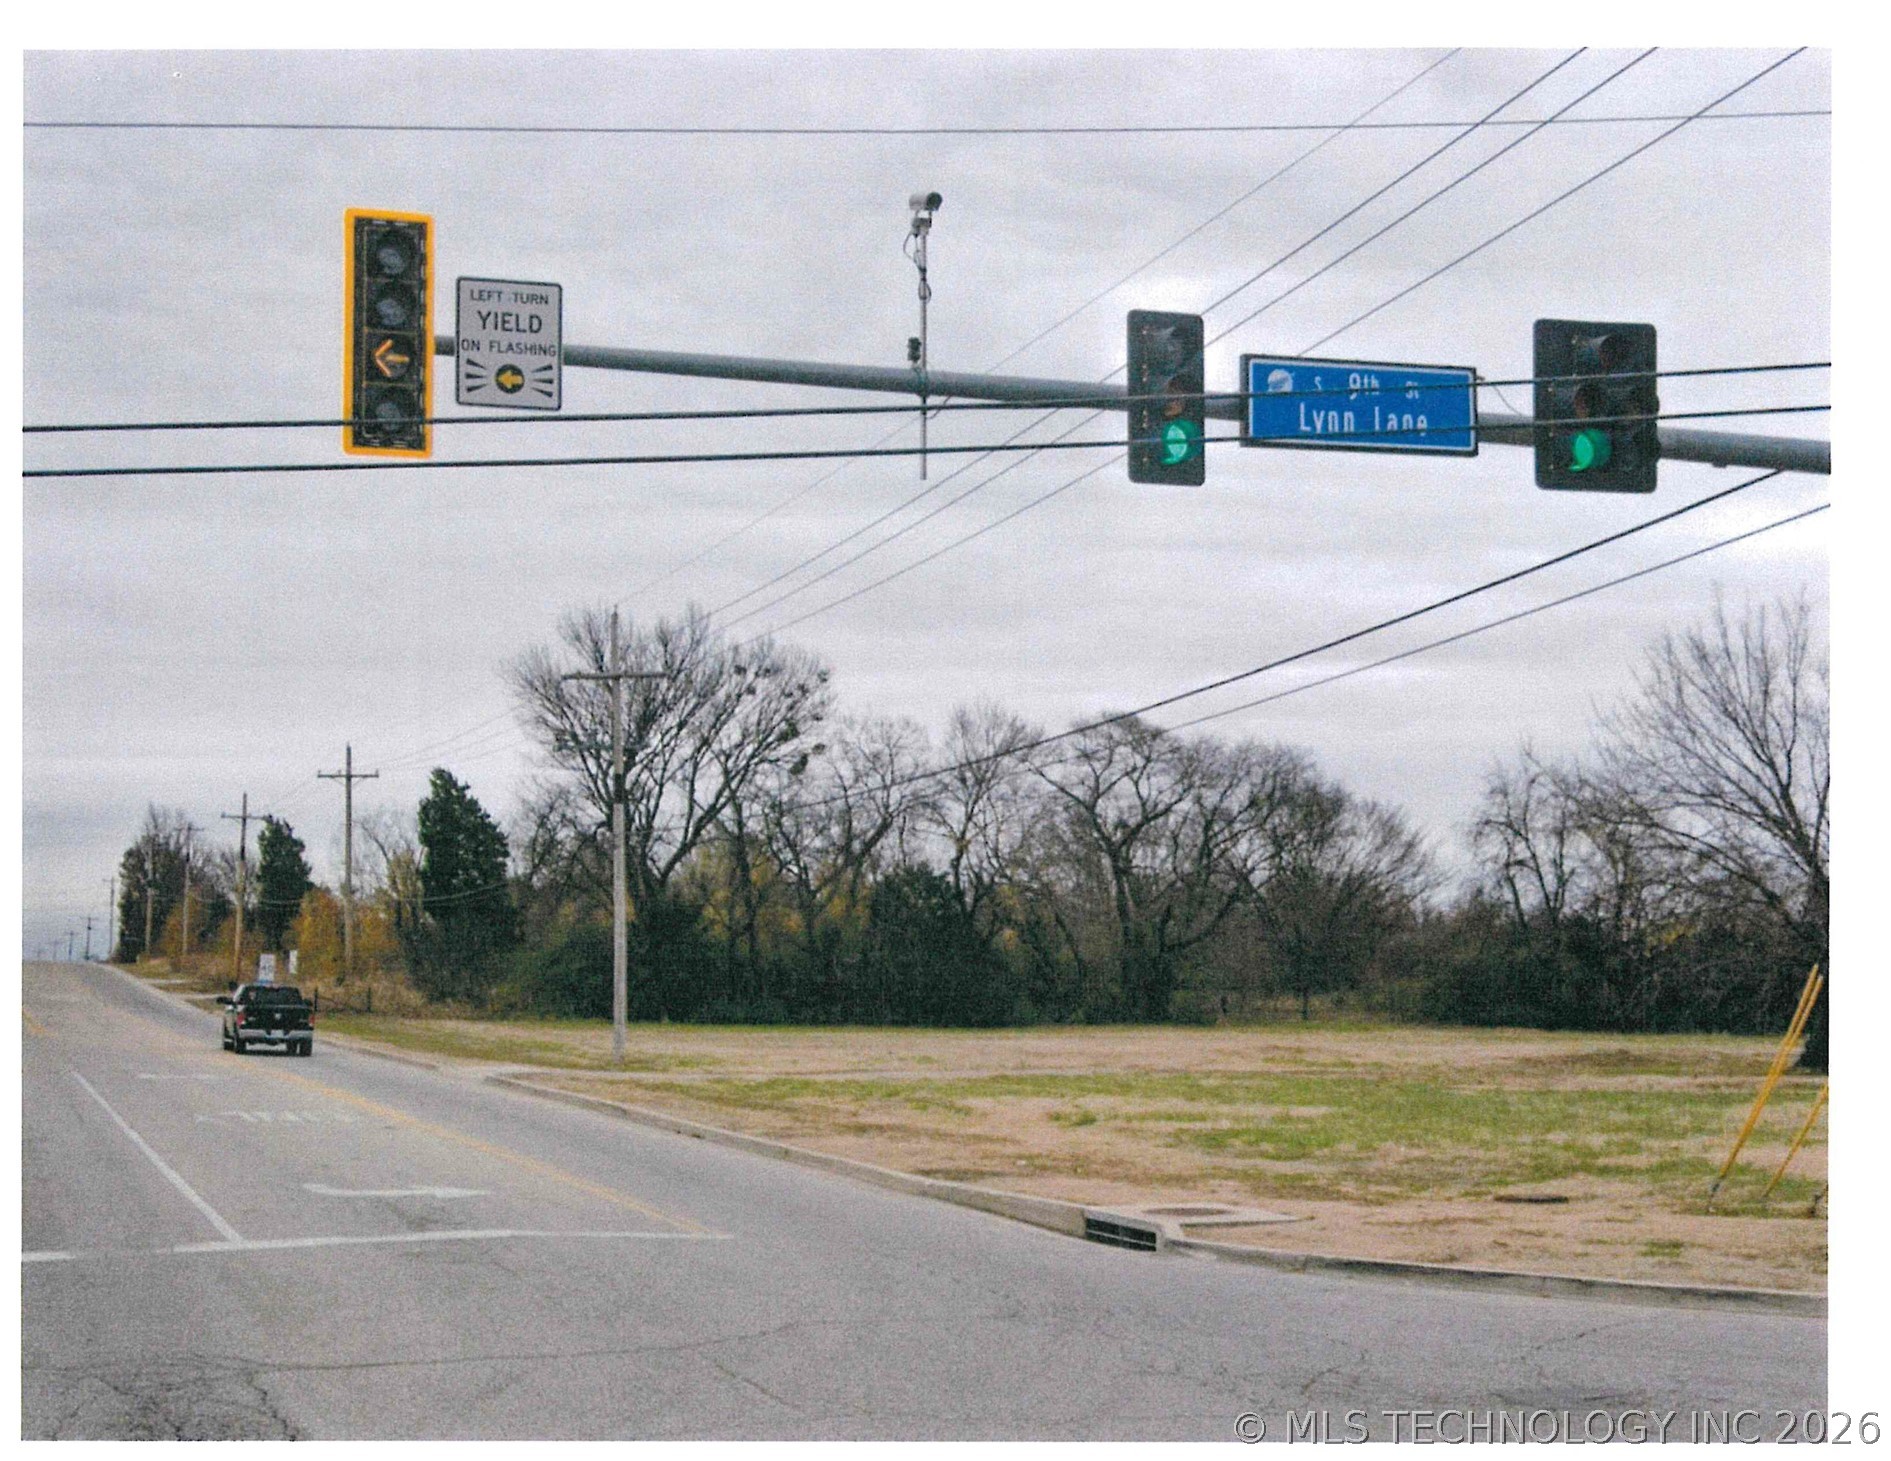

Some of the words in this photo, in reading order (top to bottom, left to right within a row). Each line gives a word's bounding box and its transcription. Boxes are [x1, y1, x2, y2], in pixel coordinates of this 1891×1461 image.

[470, 289, 502, 303] LEFT
[512, 292, 549, 305] TURN
[477, 309, 543, 333] YIELD
[461, 338, 480, 352] ON
[489, 340, 557, 357] FLASHING
[1349, 372, 1380, 400] 9th
[1299, 402, 1355, 434] Lynn
